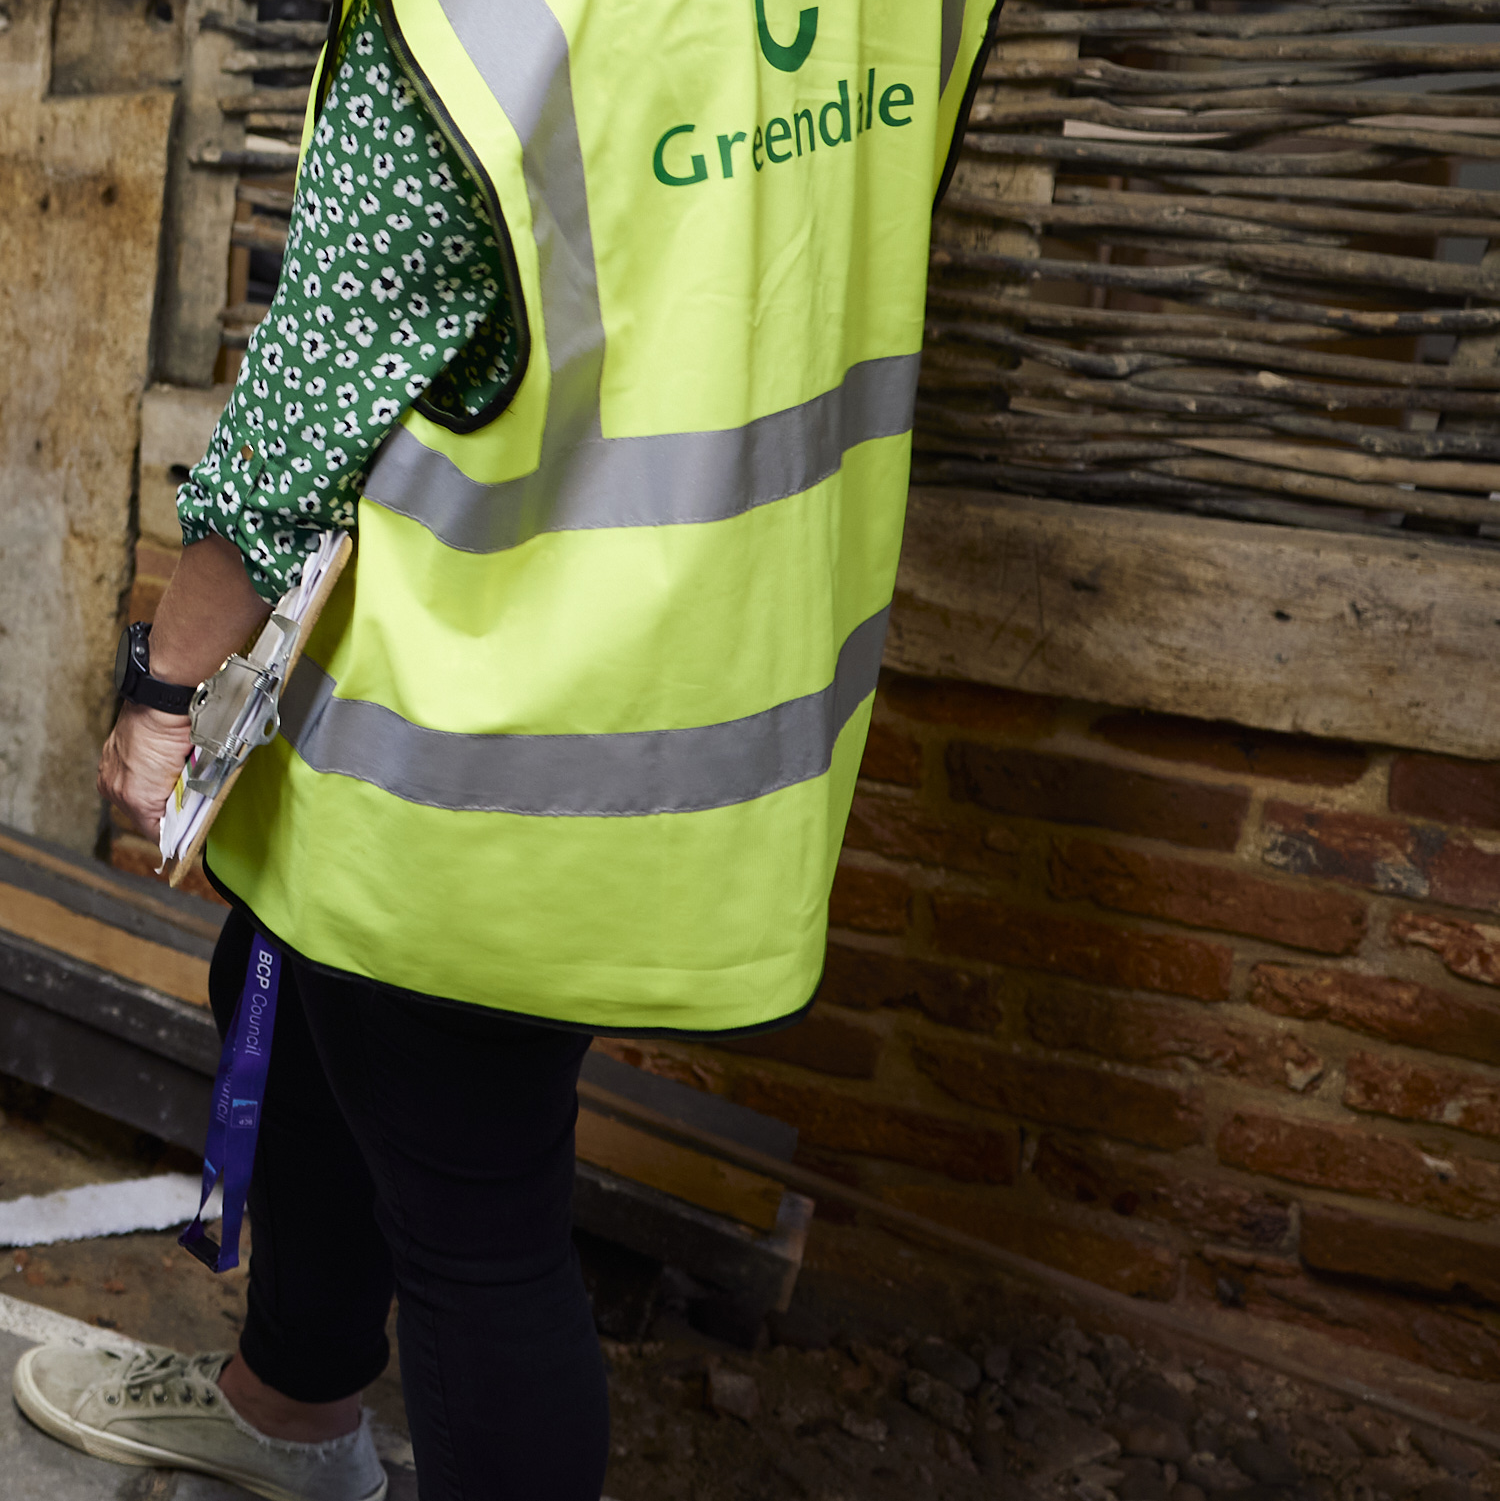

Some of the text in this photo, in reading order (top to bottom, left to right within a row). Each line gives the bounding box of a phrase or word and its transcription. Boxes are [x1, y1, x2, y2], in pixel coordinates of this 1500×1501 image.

[653, 68, 914, 187] Greendale
[245, 949, 273, 1057] BCP Council
